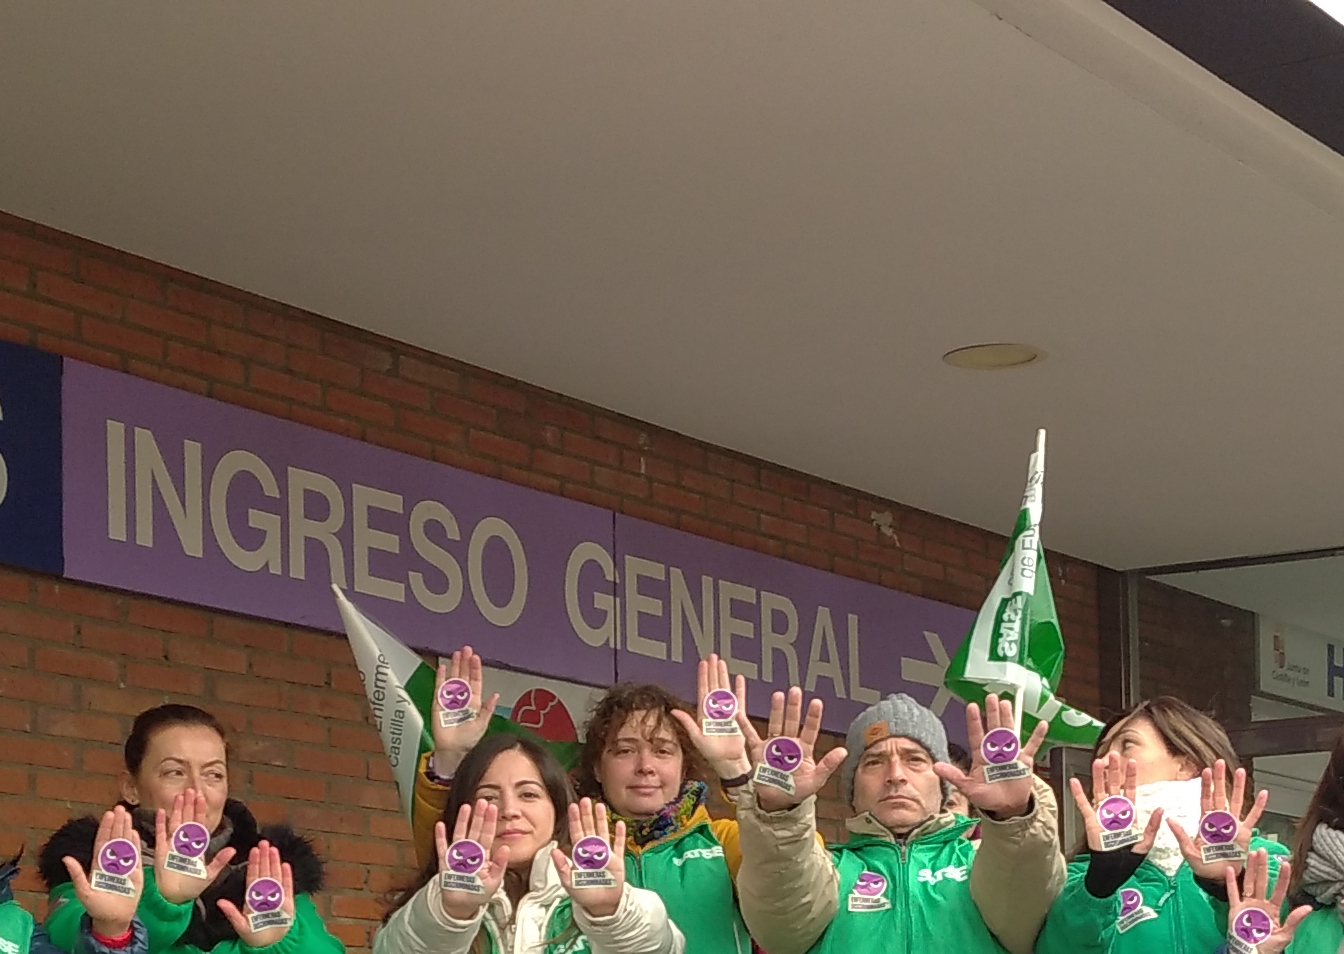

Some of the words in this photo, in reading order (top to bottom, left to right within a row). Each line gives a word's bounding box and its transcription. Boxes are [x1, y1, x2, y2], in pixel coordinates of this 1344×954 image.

[105, 419, 529, 628] INGRESO
[564, 542, 882, 705] GENERAL
[389, 708, 405, 768] Castilla
